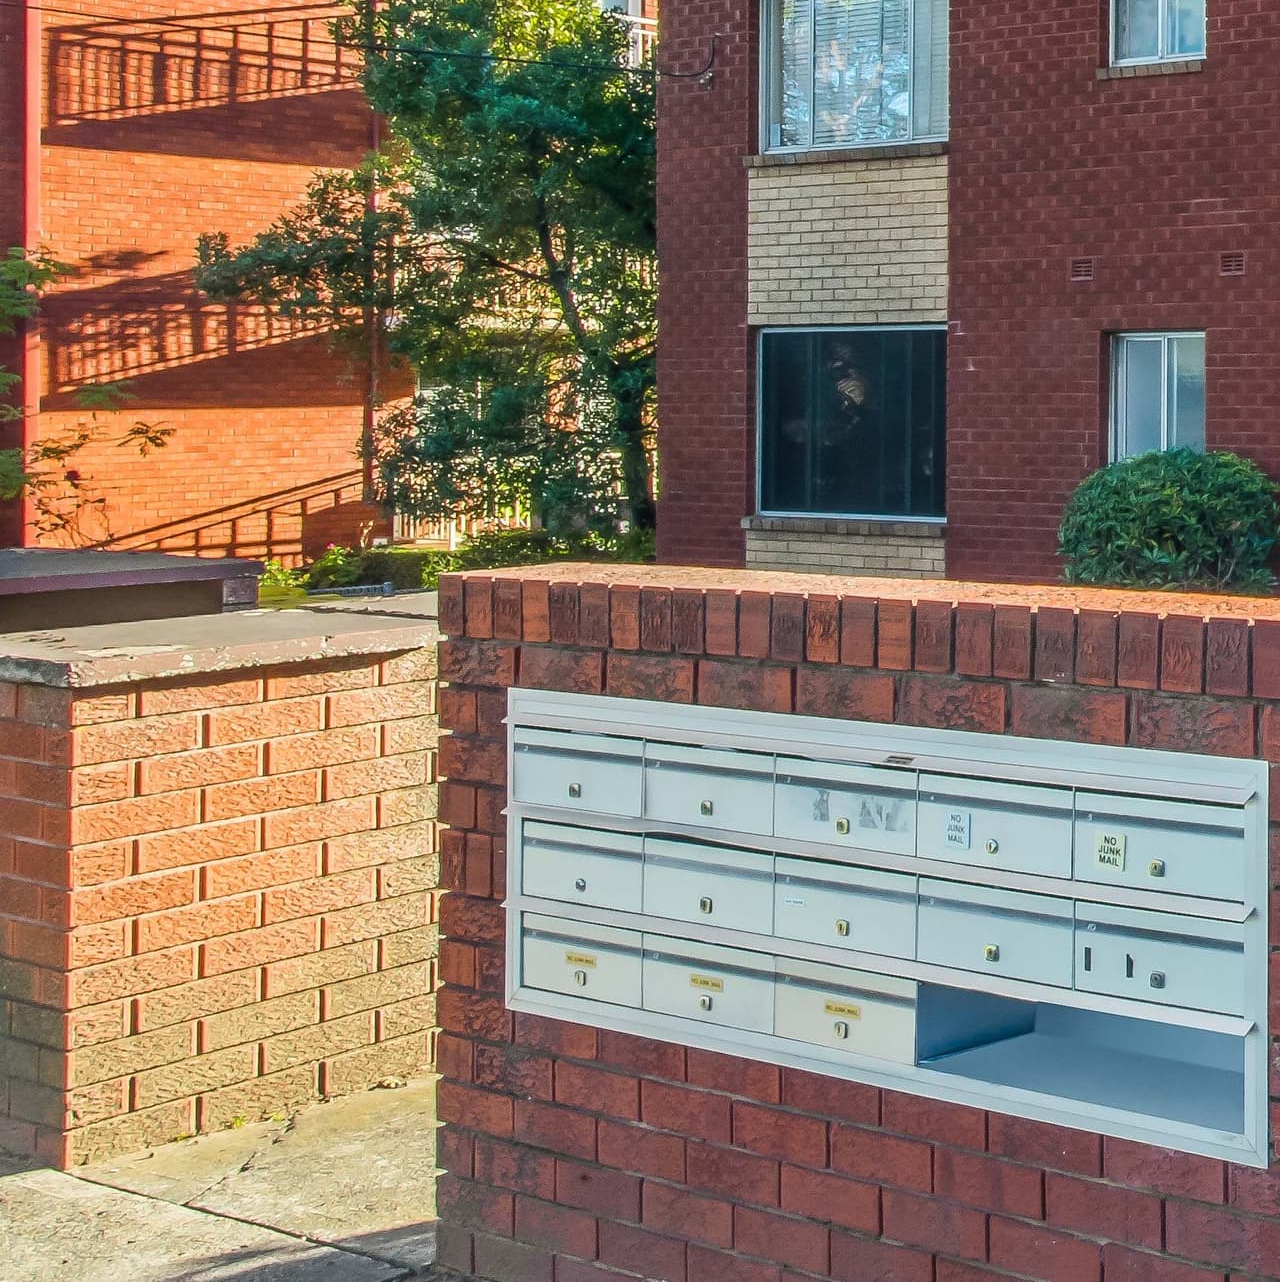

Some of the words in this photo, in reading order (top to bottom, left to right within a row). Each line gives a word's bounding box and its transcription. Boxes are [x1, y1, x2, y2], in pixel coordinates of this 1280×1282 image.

[950, 813, 962, 823] NO
[947, 824, 966, 834] JUNK
[947, 834, 964, 844] MAIL
[1103, 835, 1117, 846] NO
[1098, 845, 1121, 856] JUNK
[1098, 855, 1120, 867] MAIL
